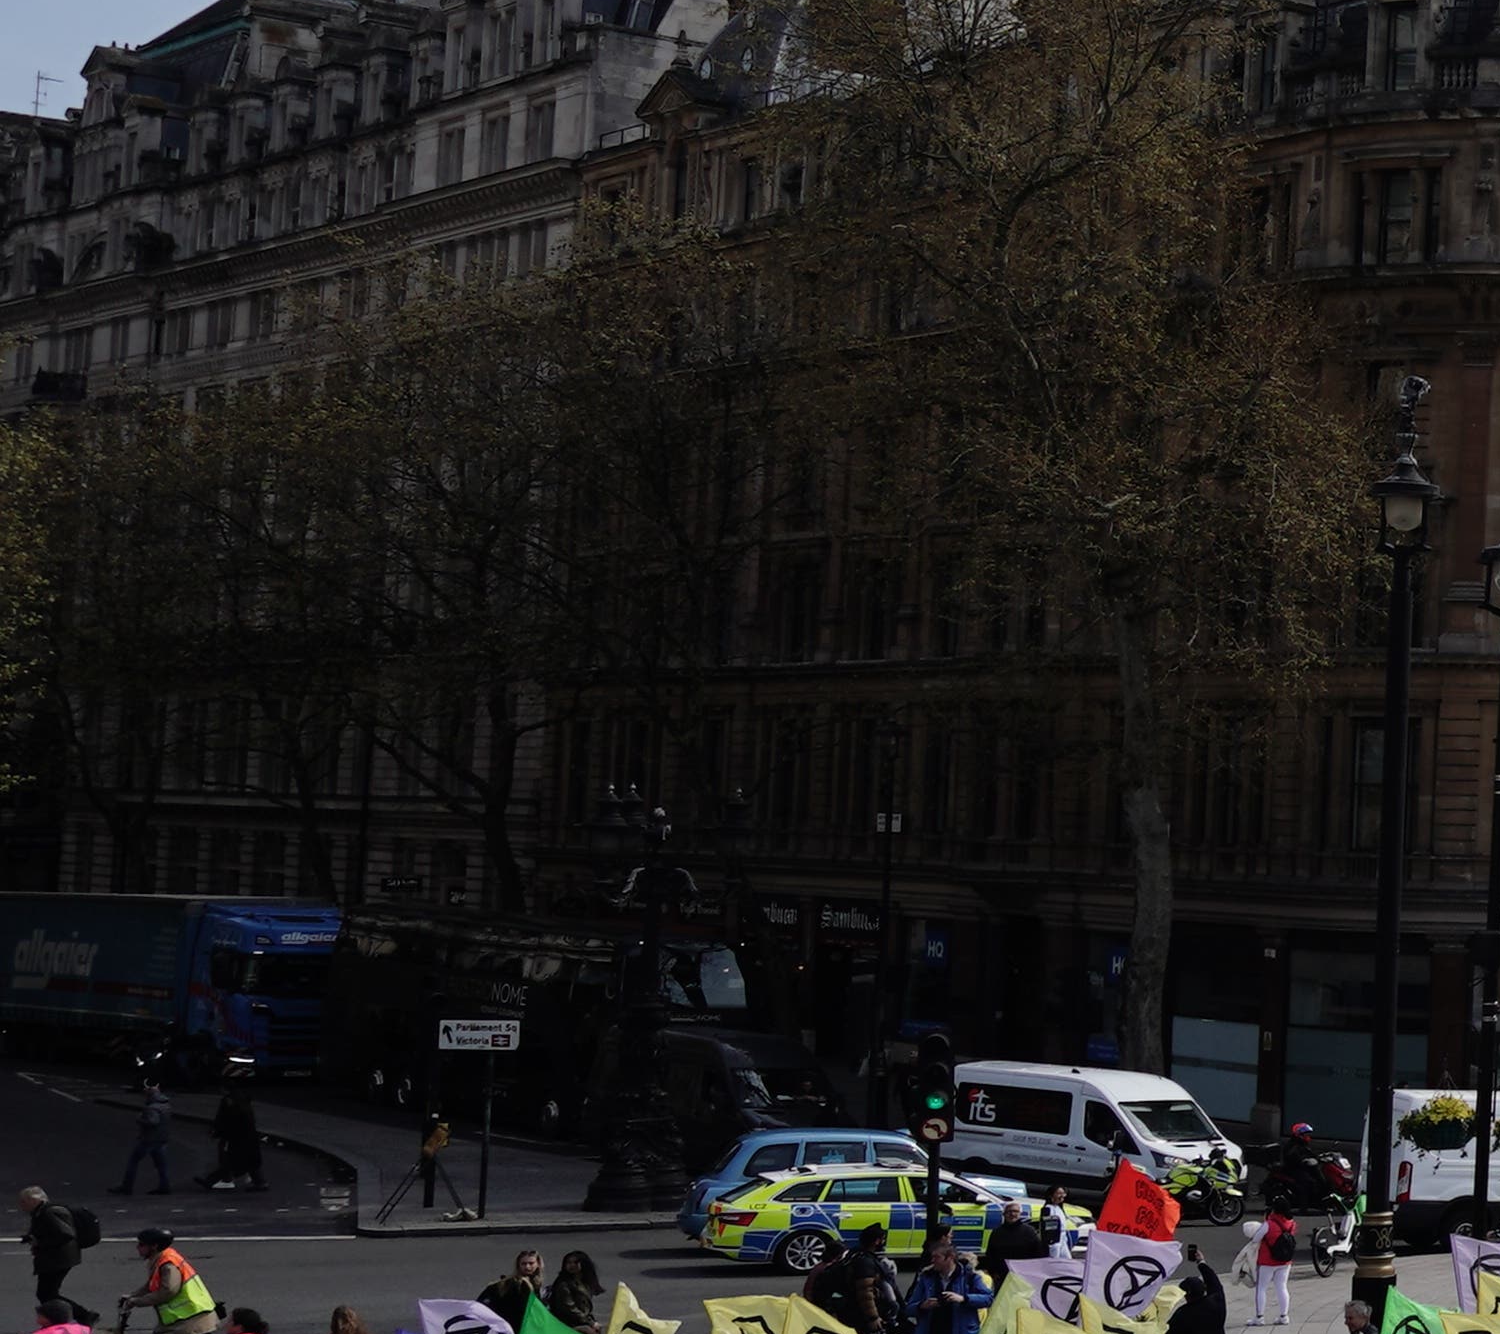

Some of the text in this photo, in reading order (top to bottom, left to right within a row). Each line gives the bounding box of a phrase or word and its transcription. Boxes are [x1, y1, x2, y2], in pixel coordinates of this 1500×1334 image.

[281, 931, 338, 949] allgaier
[928, 941, 945, 958] HQ
[456, 1036, 490, 1045] Victoria
[968, 1088, 996, 1123] its
